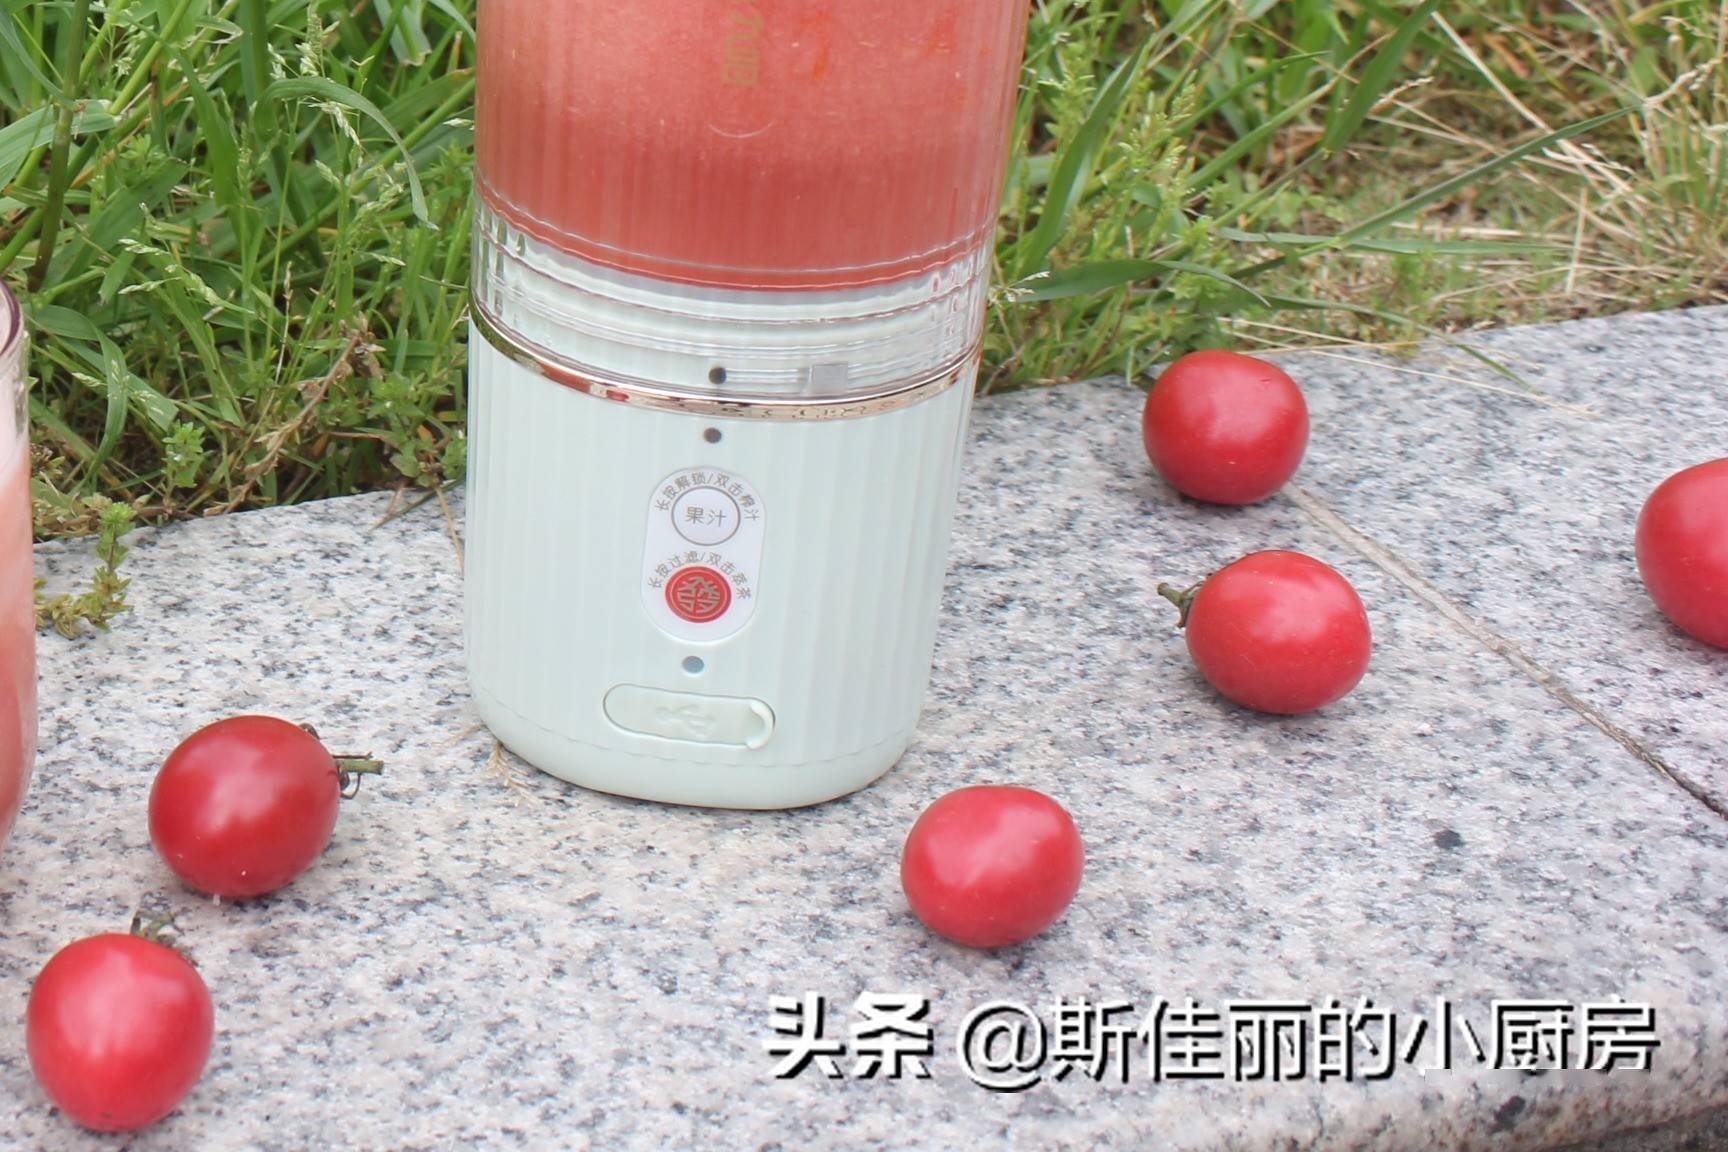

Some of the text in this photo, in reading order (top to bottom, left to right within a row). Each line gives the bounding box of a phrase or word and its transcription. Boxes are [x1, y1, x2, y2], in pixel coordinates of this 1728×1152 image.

[654, 471, 761, 521] 长按解锁/双击榨汁
[685, 506, 727, 527] 果汁
